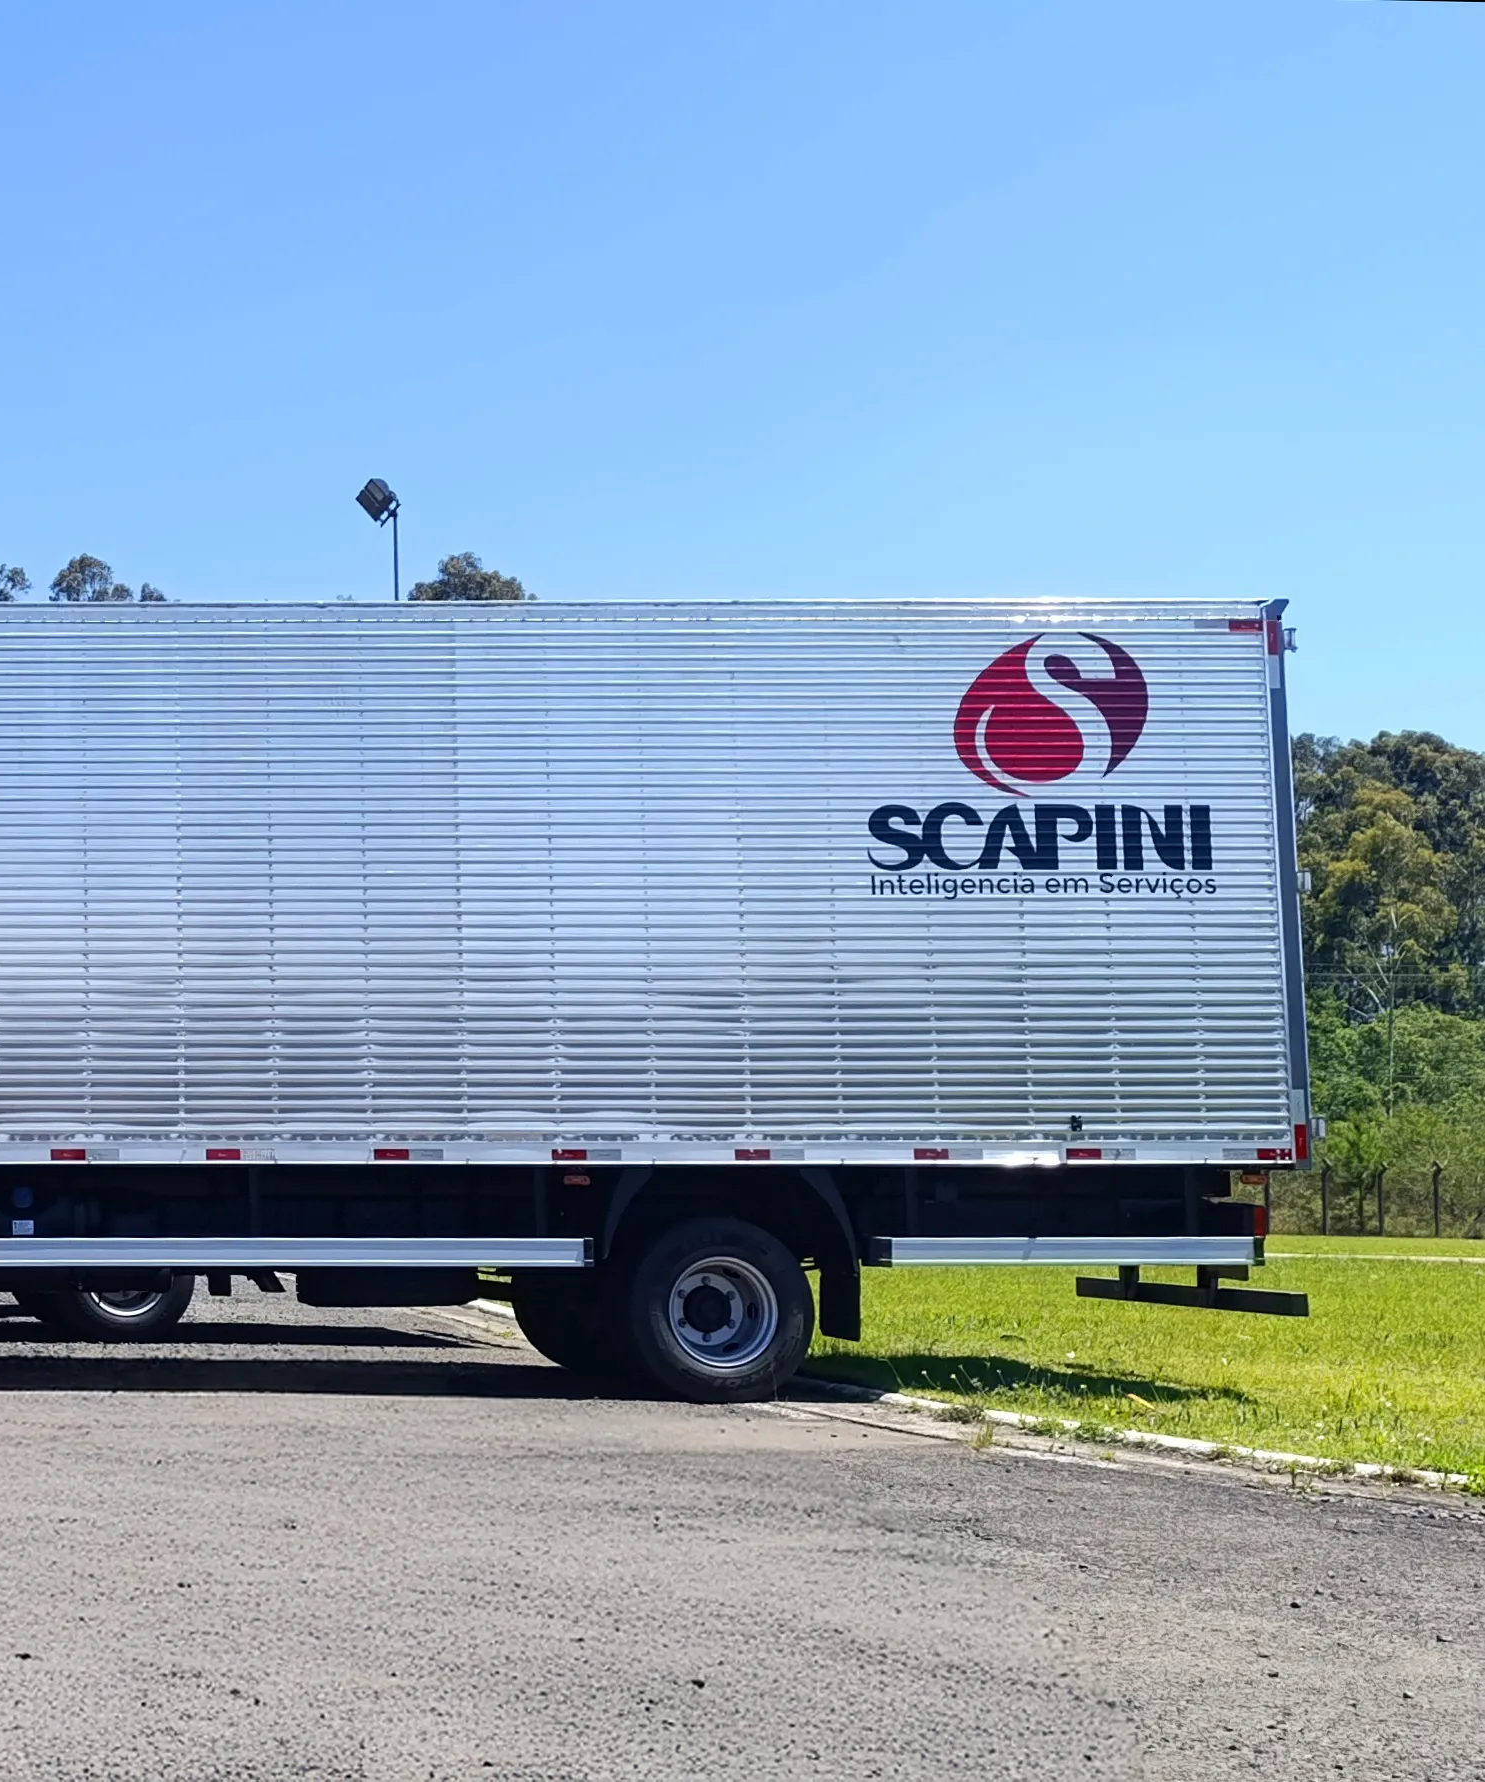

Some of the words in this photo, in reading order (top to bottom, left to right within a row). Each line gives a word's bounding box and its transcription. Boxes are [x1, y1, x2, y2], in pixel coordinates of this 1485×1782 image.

[867, 801, 1214, 872] SCAPINI
[871, 872, 1035, 900] Inteligencia
[1044, 876, 1090, 894] em
[1099, 872, 1218, 900] Serviços
